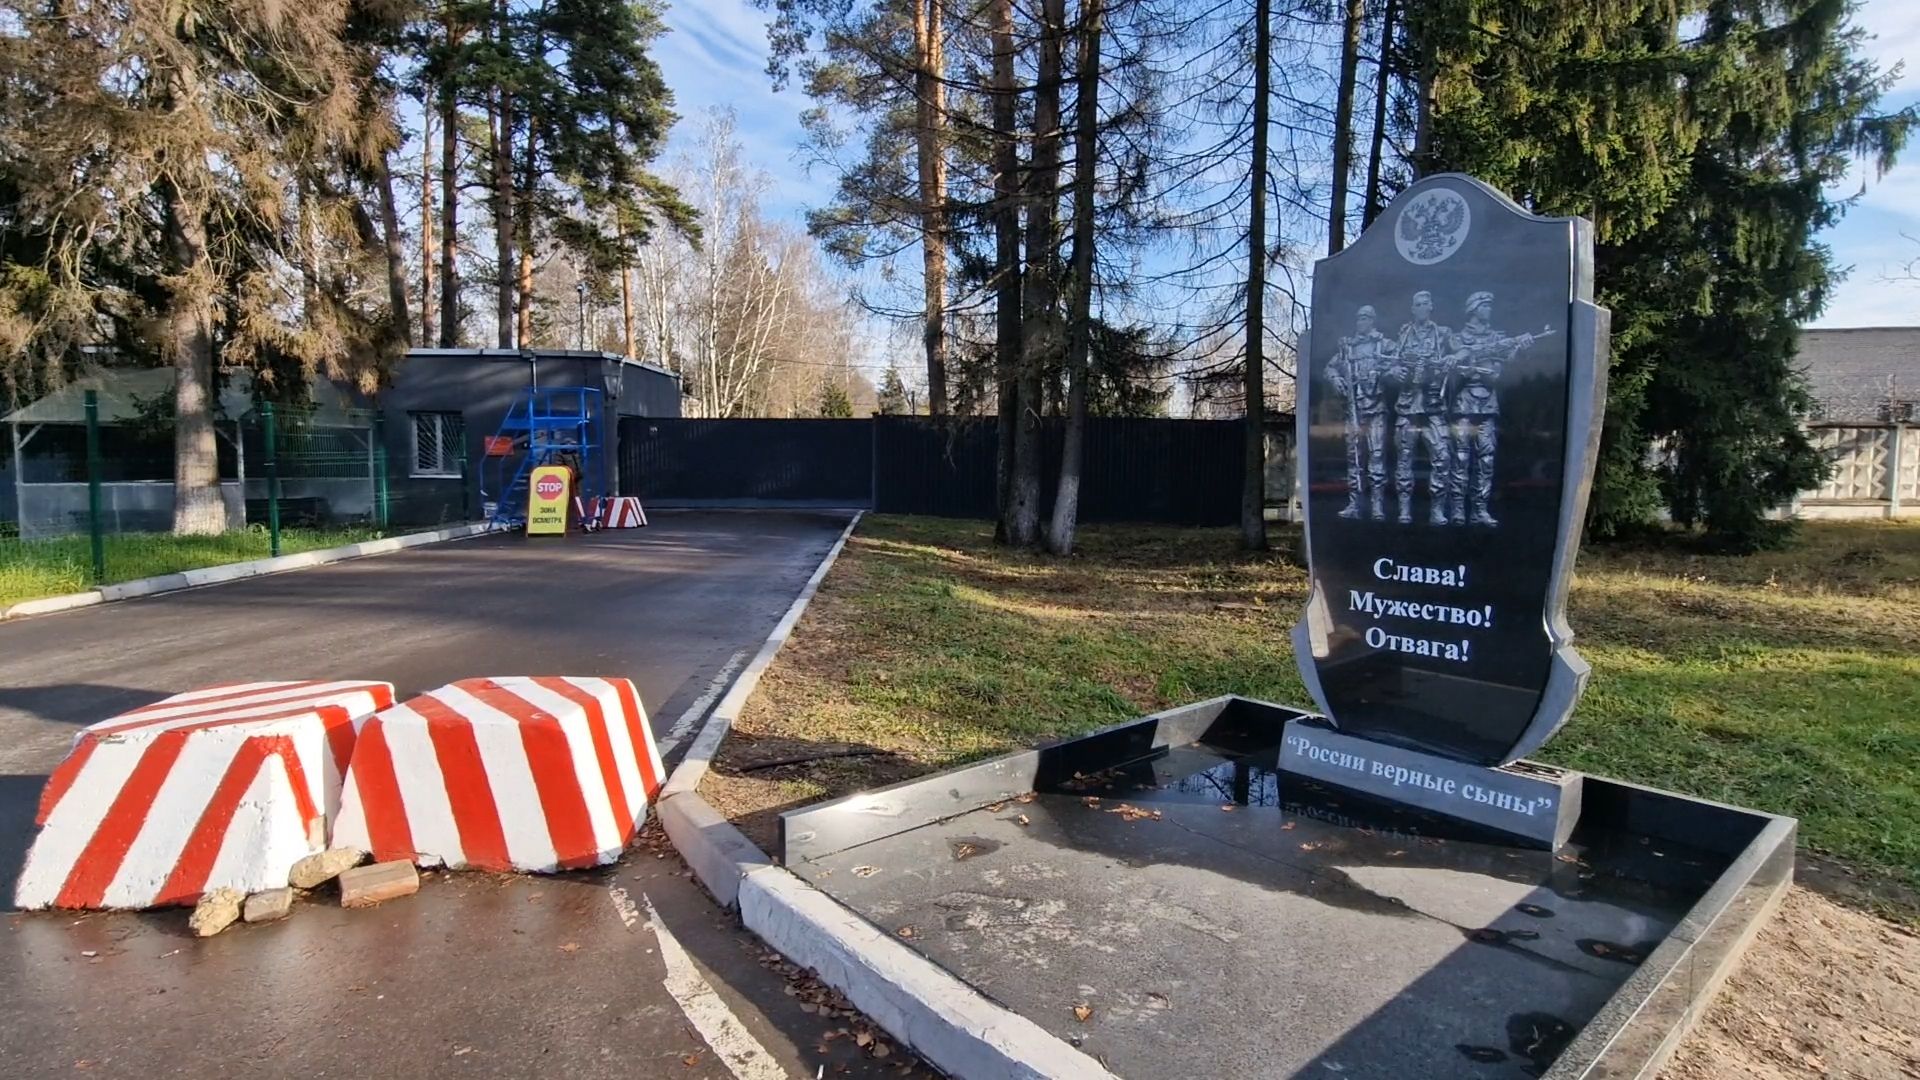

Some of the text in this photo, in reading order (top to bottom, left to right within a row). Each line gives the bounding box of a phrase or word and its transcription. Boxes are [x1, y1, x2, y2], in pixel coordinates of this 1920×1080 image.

[538, 482, 562, 493] STOP
[1373, 557, 1466, 588] Слава!
[1348, 589, 1492, 628] Мужество!
[1365, 626, 1470, 662] Отвага!
[1287, 734, 1552, 817] “России верные сыны”
